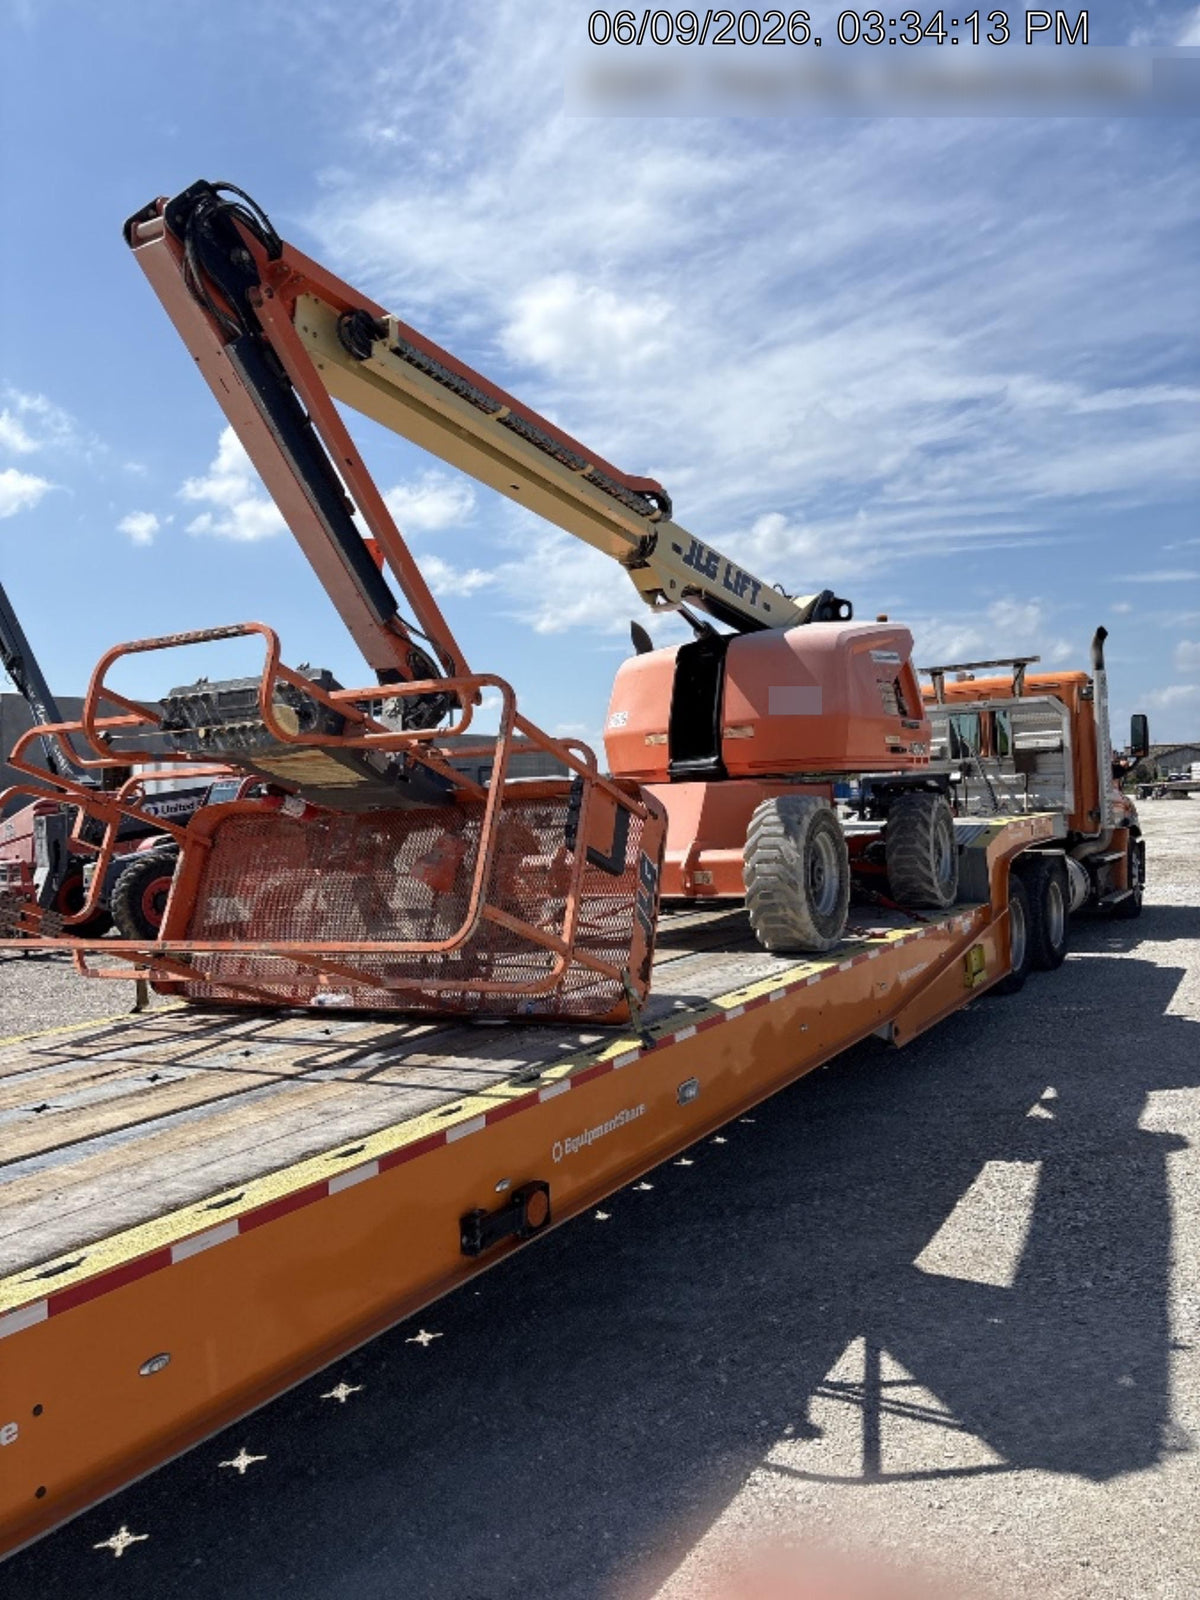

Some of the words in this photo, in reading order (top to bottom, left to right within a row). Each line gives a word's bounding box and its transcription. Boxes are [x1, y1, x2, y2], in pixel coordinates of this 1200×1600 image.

[682, 539, 720, 582] JLG
[723, 563, 762, 606] LIFT
[564, 1103, 646, 1155] EquipmentShare
